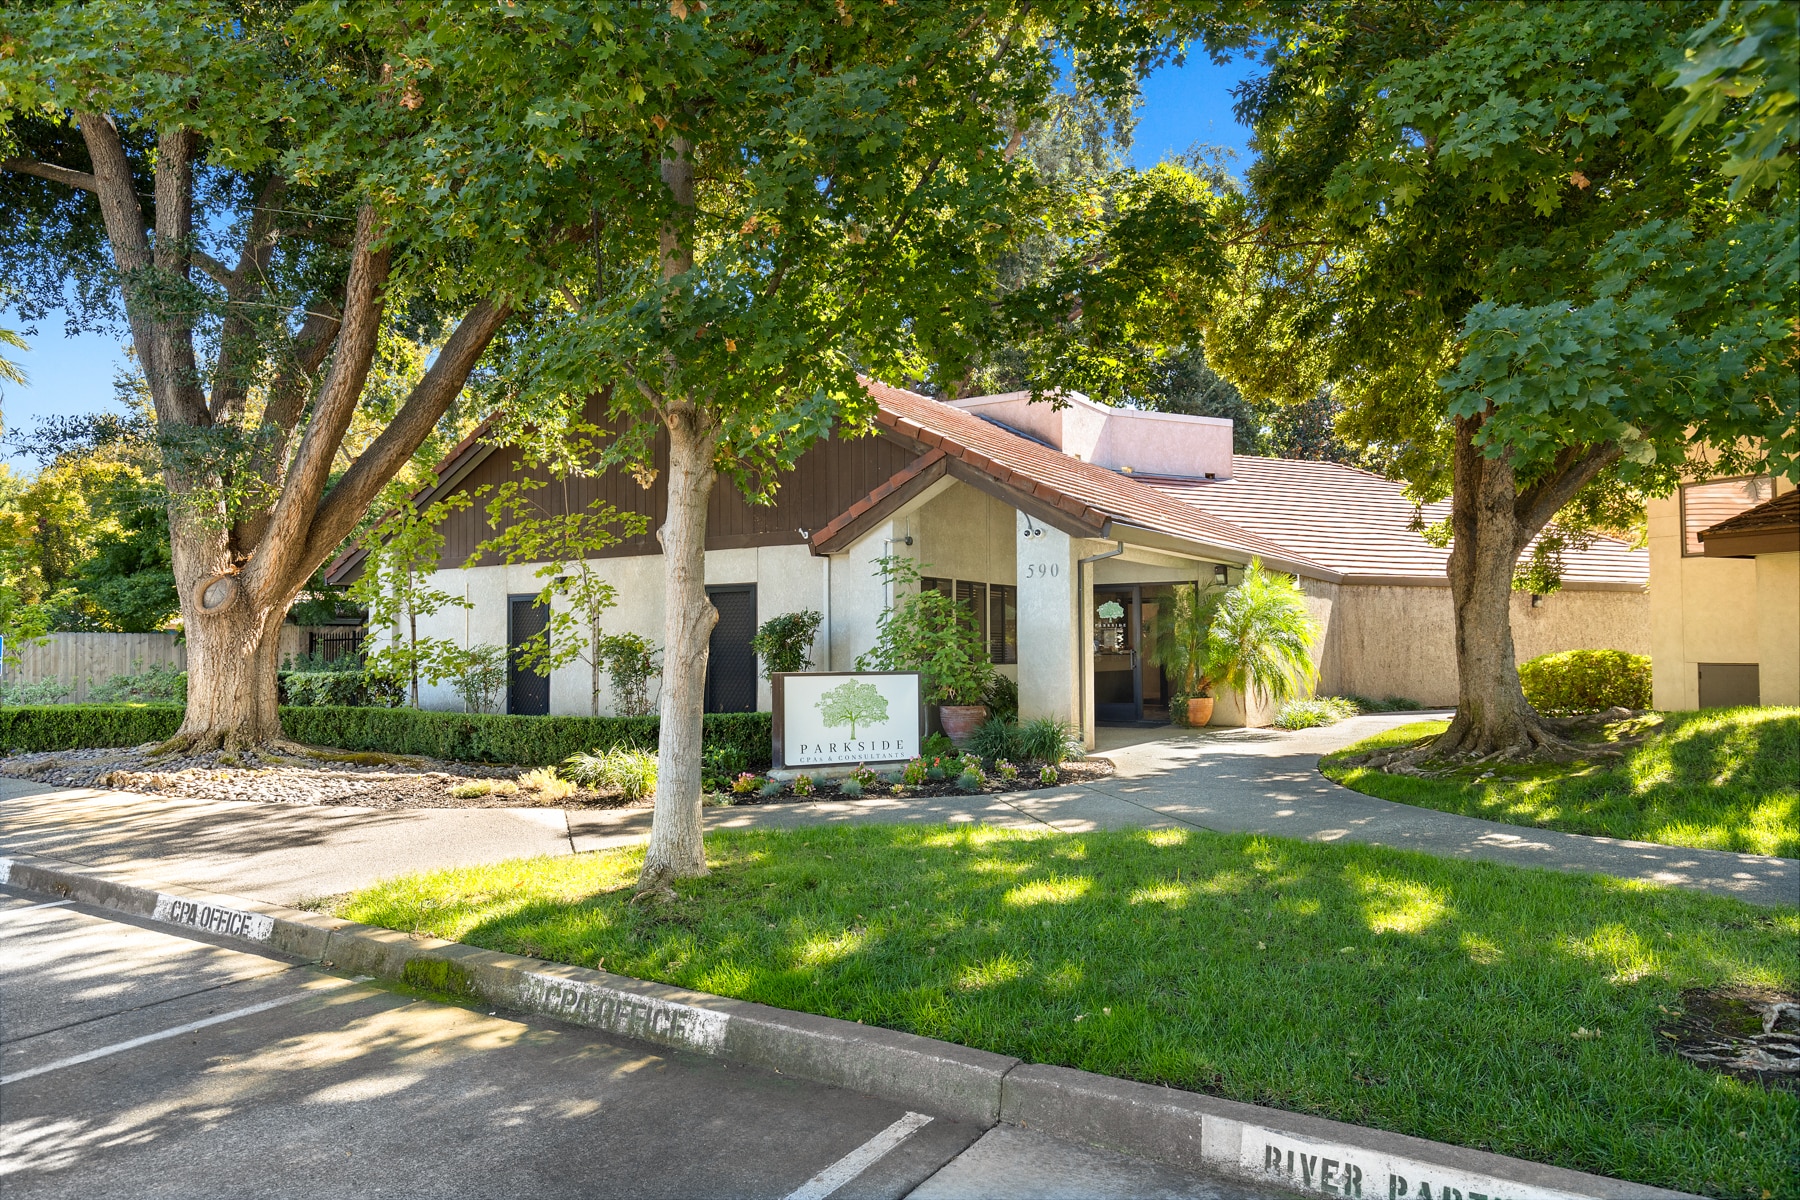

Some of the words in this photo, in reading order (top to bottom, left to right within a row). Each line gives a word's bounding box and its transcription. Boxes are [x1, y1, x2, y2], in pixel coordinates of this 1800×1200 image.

[1025, 563, 1059, 579] 590
[800, 740, 904, 754] PARKSIDE
[838, 752, 905, 762] CONSULTANTS
[170, 900, 198, 926] CPA
[199, 906, 253, 937] OFFICE
[1265, 1143, 1363, 1199] RIVER
